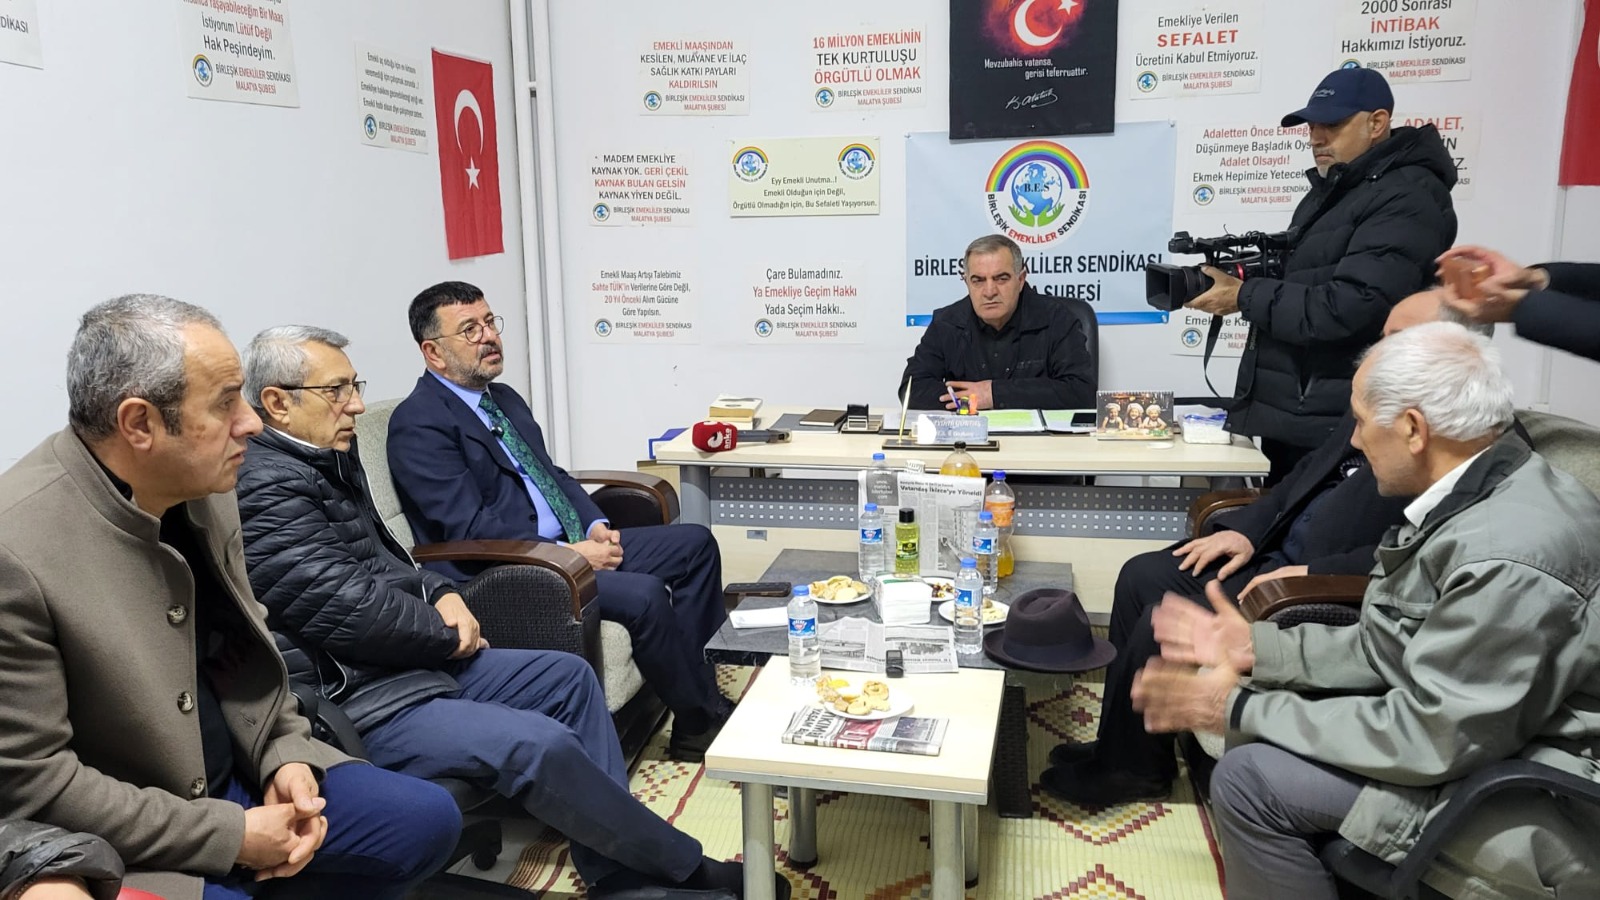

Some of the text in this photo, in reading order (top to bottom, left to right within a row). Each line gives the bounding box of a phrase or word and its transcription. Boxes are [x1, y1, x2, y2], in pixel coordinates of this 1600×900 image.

[1361, 1, 1398, 14] 2000
[260, 7, 268, 20] Bir
[268, 9, 284, 27] Maaş
[1158, 13, 1238, 28] Emekliye Verilen
[0, 14, 28, 34] DİKASI
[201, 12, 234, 33] İstiyorum
[255, 26, 272, 42] Değil
[1371, 16, 1440, 34] İNTİBAK
[813, 29, 921, 49] 16 MİLYON EMEKLİNİN
[1157, 30, 1238, 48] SEFALET
[1342, 33, 1466, 53] Hakkımızı İstiyoruz.
[203, 35, 276, 61] Hak Peşindeyim.
[654, 40, 733, 52] EMEKLİ MAAŞINDAN
[640, 52, 747, 65] KESİLEN, MUAYANE VE İLAÇ
[817, 48, 917, 66] TEK KURTULUŞU
[1135, 50, 1258, 67] Ücretini Kabul Etmiyoruz.
[1396, 58, 1430, 67] EMEKLİLER
[1431, 56, 1465, 65] SENDİKASI
[984, 58, 1022, 69] Mevzubahis
[651, 65, 736, 76] SAĞLIK KATKI PAYLARI
[814, 66, 921, 84] ÖRGÜTLÜ OLMAK
[1025, 69, 1045, 80] gerisi
[1162, 69, 1255, 82] BİRLEŞİK EMEKLİLER SENDİKASI
[1389, 68, 1442, 78] MALATYA ŞUBESİ
[669, 80, 718, 89] KALDIRILSIN
[1183, 80, 1232, 90] MALATYA ŞUBESİ
[666, 93, 745, 102] BİRLEŞİK EMEKLİLER SENDİKASI
[838, 86, 922, 98] BİRLEŞİK EMEKLİLER SENDİKASI
[882, 97, 902, 106] ŞUBESİ
[707, 103, 726, 112] ŞUBESİ
[1203, 128, 1248, 139] Adaletten
[1250, 125, 1274, 137] Önce
[1196, 140, 1312, 155] Düşünmeye Başladık Oys
[603, 153, 675, 163] MADEM EMEKLİYE
[1220, 155, 1290, 167] Adalet Olsaydı!
[592, 166, 689, 177] KAYNAK YOK. GERİ ÇEKİL
[1193, 169, 1307, 182] Ekmek Hepimize Yetecek
[595, 179, 686, 188] KAYNAK BULAN GELSİN
[771, 178, 780, 186] Eyy
[786, 188, 812, 197] Olduğun
[814, 188, 825, 196] için
[1024, 183, 1050, 193] B.E.S
[1219, 184, 1312, 195] BİRLEŞİK EMEKLİLER SENDİKA
[599, 190, 681, 200] KAYNAK YİYEN DEĞİL.
[1241, 196, 1267, 204] MALATYA
[613, 206, 635, 214] BİRLEŞİK
[663, 206, 690, 214] SENDİKASI
[733, 201, 756, 210] Örgütlü
[757, 201, 789, 209] Olmadığın
[987, 191, 1087, 244] BİRLEŞİK EMEKLİLER SENDİKASI
[914, 254, 965, 281] BİRLEŞ
[1021, 252, 1073, 274] KLİLER
[601, 270, 619, 279] Emekli
[621, 271, 636, 280] Maaş
[654, 271, 681, 279] Talebimiz
[766, 268, 843, 283] Çare Bulamadınız.
[592, 283, 608, 291] Sahte
[631, 283, 658, 291] Verilerine
[658, 283, 672, 291] Göre
[674, 283, 690, 293] Değil,
[753, 285, 857, 300] Ya Emekliye Geçim Hakkı
[604, 295, 612, 303] 20
[622, 294, 641, 303] Önceki
[642, 295, 655, 304] Alım
[657, 295, 678, 304] Gücüne
[622, 307, 661, 317] Göre Yapılsın.
[765, 303, 845, 317] Yada Seçim Hakkı..
[776, 321, 799, 329] BİRLEŞİK
[900, 485, 928, 493] Vatandaş
